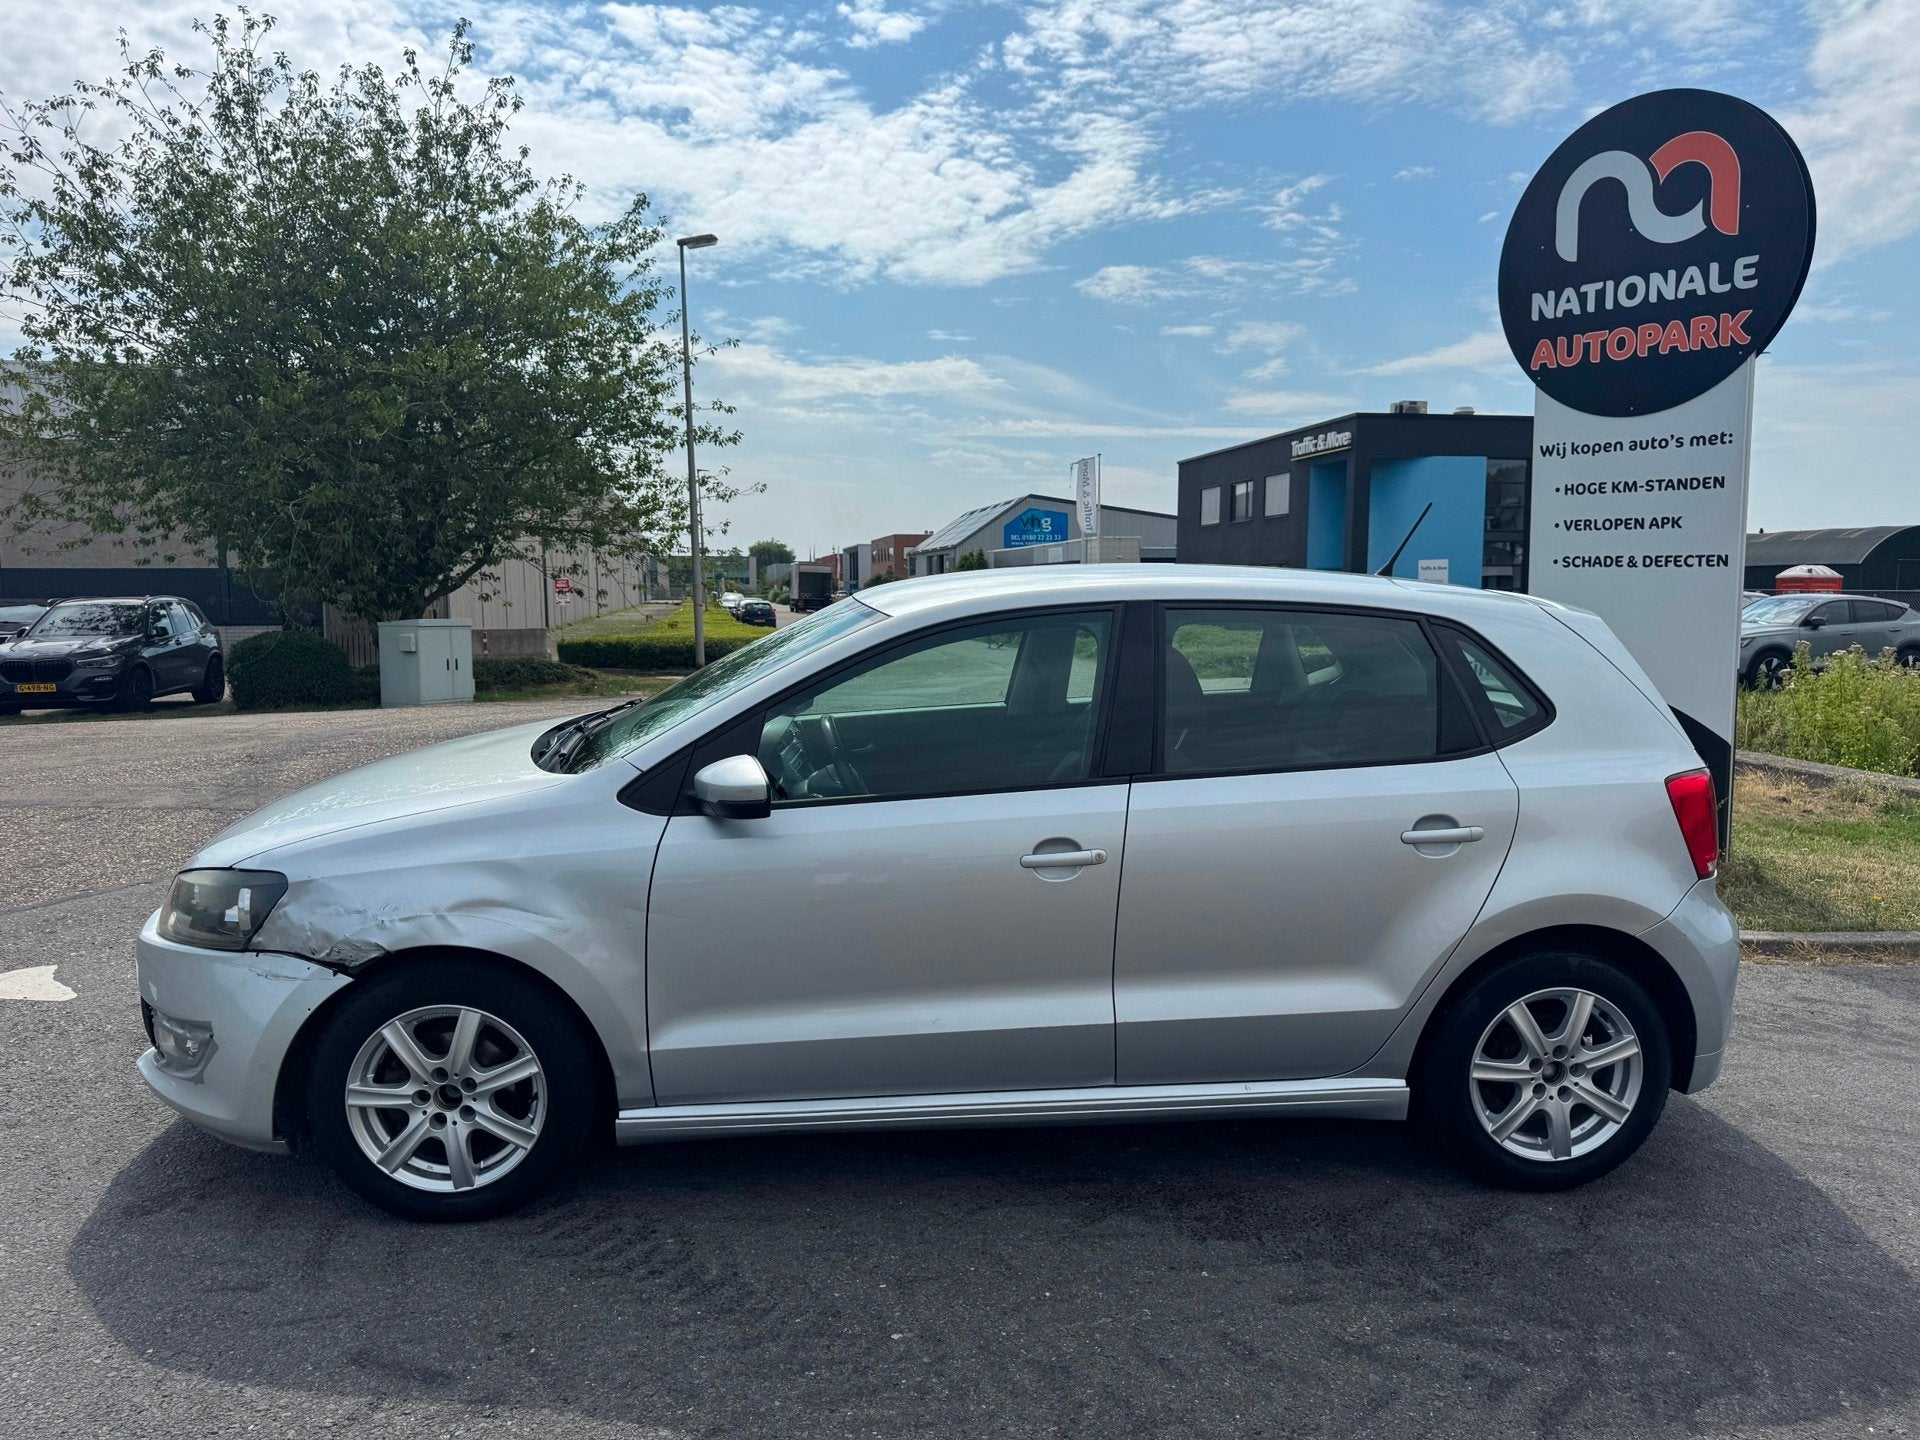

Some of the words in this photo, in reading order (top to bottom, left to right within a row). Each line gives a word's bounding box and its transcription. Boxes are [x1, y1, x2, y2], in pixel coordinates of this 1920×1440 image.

[1531, 255, 1760, 321] NATIONALE
[1530, 309, 1753, 370] AUTOPARK
[1291, 436, 1317, 456] Traffic
[1317, 434, 1326, 451] &
[1326, 431, 1352, 448] More
[1540, 442, 1567, 459] Wij
[1571, 440, 1624, 456] kopen
[1690, 431, 1733, 447] met:
[1564, 481, 1607, 496] HOGE
[1611, 475, 1725, 494] KM-STANDEN
[1564, 517, 1645, 531] VERLOPEN
[1649, 516, 1683, 529] APK
[1562, 555, 1624, 568] SCHADE
[1626, 555, 1638, 568] &
[1642, 554, 1729, 568] DEFECTEN
